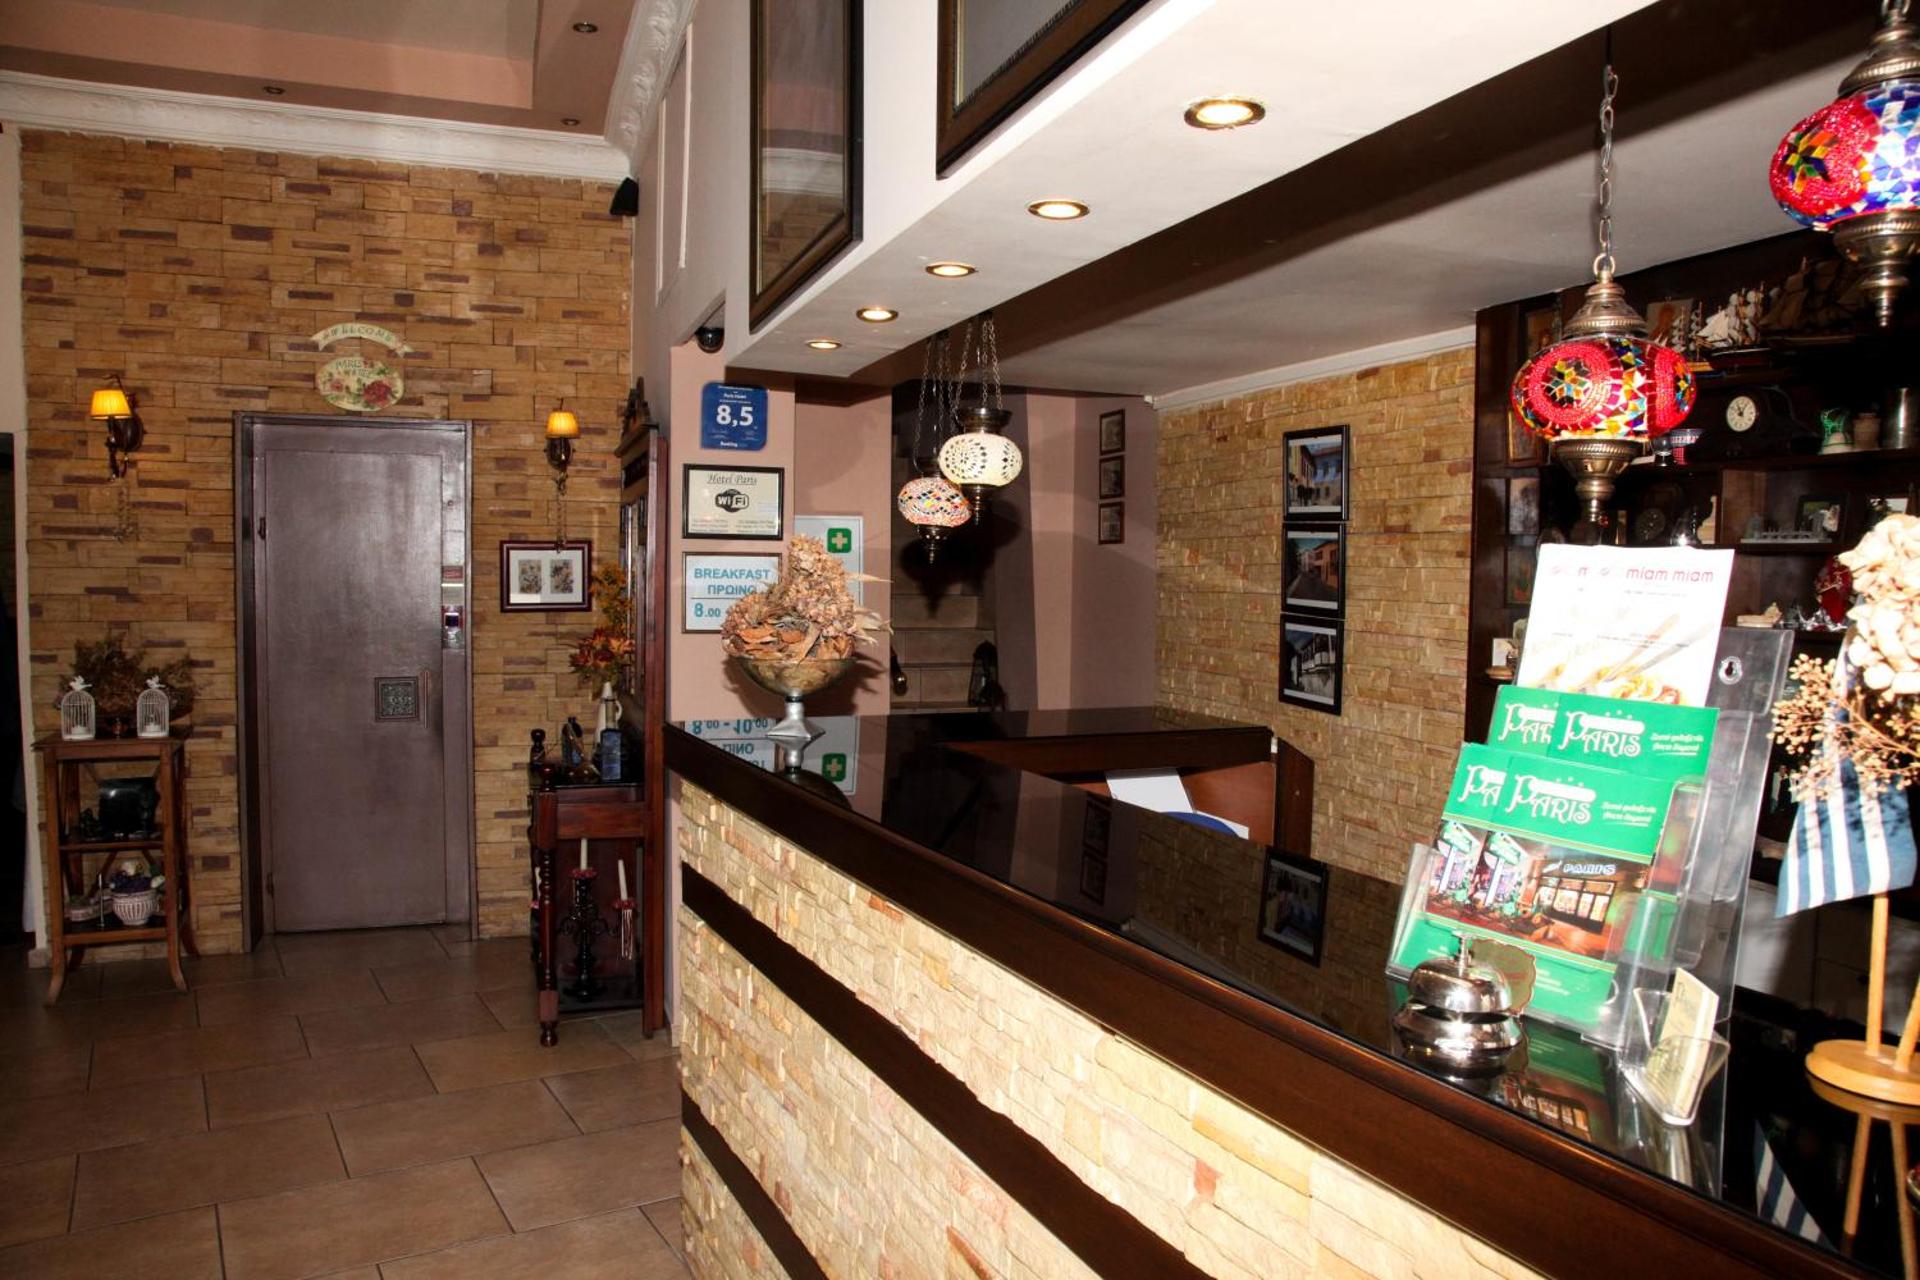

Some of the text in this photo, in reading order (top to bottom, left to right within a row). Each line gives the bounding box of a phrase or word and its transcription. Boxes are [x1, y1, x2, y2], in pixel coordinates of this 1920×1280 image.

[716, 404, 753, 427] 8,5
[707, 473, 757, 485] Hotel Paris
[694, 568, 770, 580] BREAKFAST
[1625, 566, 1714, 583] miam miam
[694, 602, 722, 618] 8.00
[1558, 711, 1642, 758] PARIS
[1505, 774, 1592, 825] PARIS
